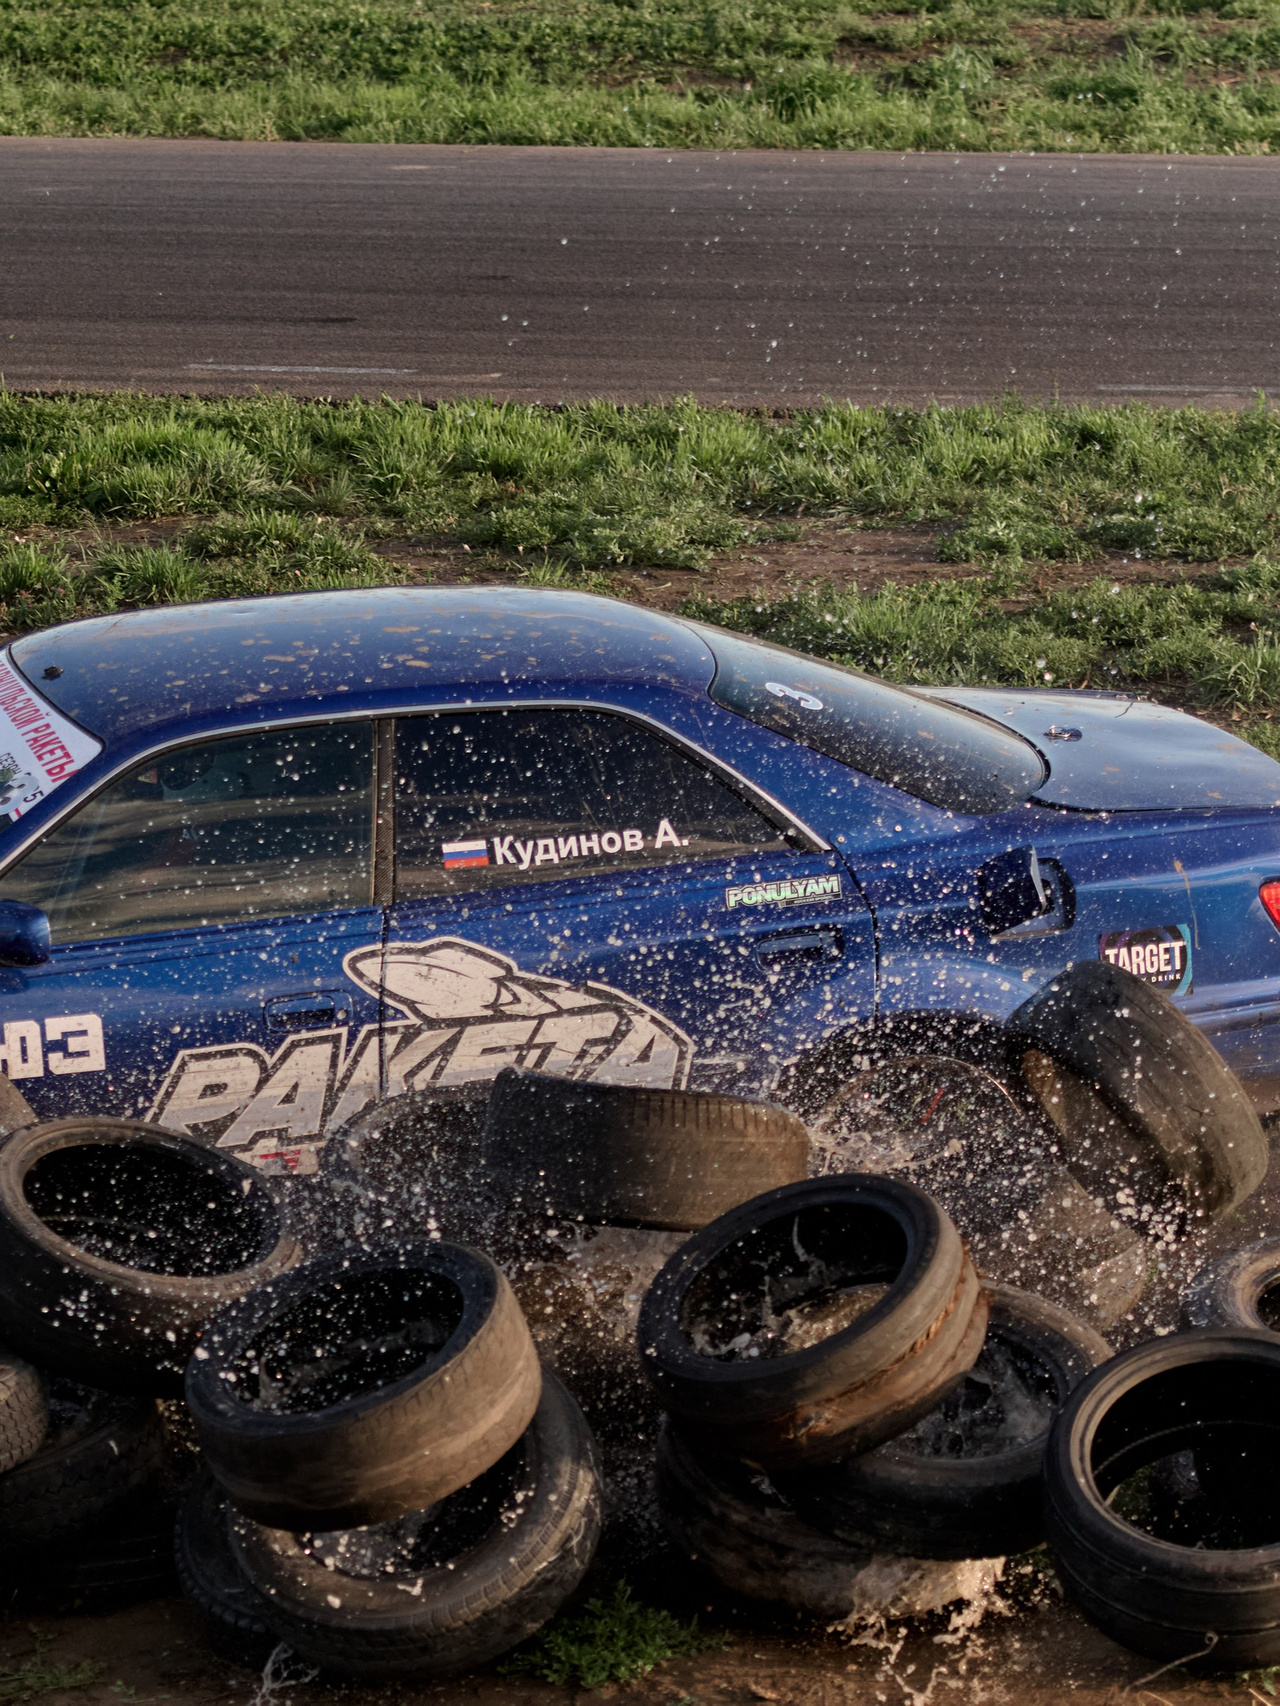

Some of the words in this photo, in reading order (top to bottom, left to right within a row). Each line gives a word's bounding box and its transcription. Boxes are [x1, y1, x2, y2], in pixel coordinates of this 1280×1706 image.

[21, 723, 82, 783] РАКЕТЫ
[493, 829, 645, 871] Кудинов
[654, 818, 690, 849] А.
[727, 875, 840, 908] PONULYAM
[1104, 941, 1186, 975] TARGET
[1151, 973, 1181, 983] DRINK
